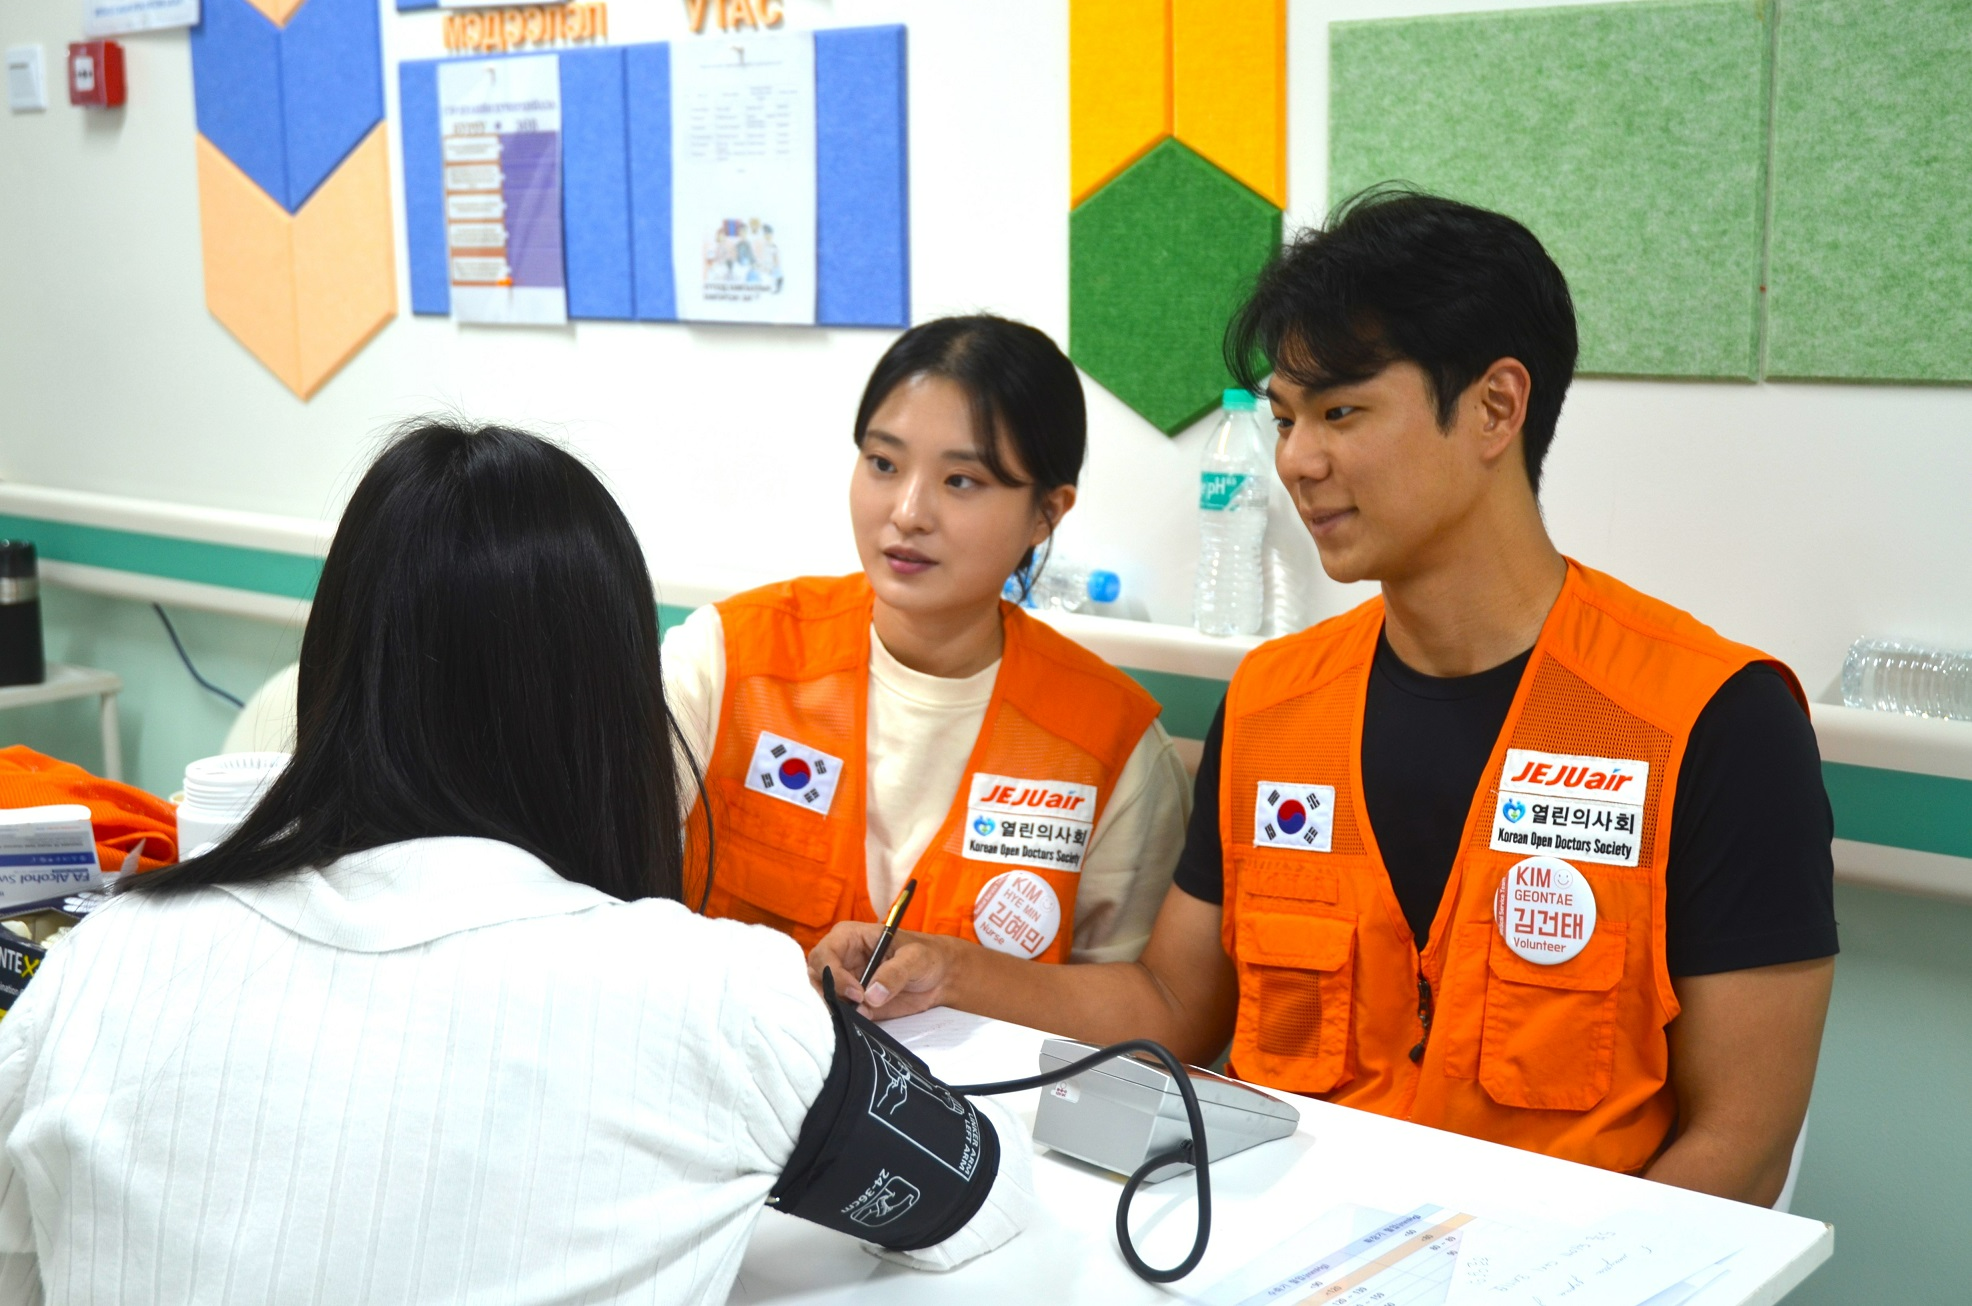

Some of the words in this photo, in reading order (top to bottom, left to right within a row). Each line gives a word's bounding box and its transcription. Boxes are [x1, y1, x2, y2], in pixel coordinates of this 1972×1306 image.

[1511, 761, 1634, 792] JEJUair
[981, 785, 1086, 811] JEJUair
[1532, 804, 1635, 835] 열린의사회
[1001, 821, 1088, 847] 열린의사회
[1498, 828, 1529, 846] Korean
[1530, 832, 1553, 850] Open
[1555, 835, 1591, 853] Doctors
[1594, 839, 1633, 860] Society
[969, 840, 998, 854] Korean
[1000, 844, 1020, 858] Open
[1022, 846, 1055, 861] Doctors
[1056, 850, 1081, 867] Society
[20, 871, 69, 885] Alcohol
[1011, 876, 1043, 904] KIM
[1516, 866, 1551, 888] KIM
[1003, 888, 1024, 908] HYE
[1022, 903, 1042, 923] MIN
[1514, 889, 1573, 906] GEONTAE
[980, 921, 1005, 945] Nurse
[988, 901, 1045, 955] 김혜민
[1514, 907, 1583, 940] 김건태
[1514, 936, 1567, 953] Volunteer
[964, 1119, 972, 1144] LEFT
[967, 1112, 979, 1148] LINKER
[958, 1143, 971, 1171] ARM
[964, 1147, 977, 1176] ARM
[841, 1168, 890, 1213] 24-36cm
